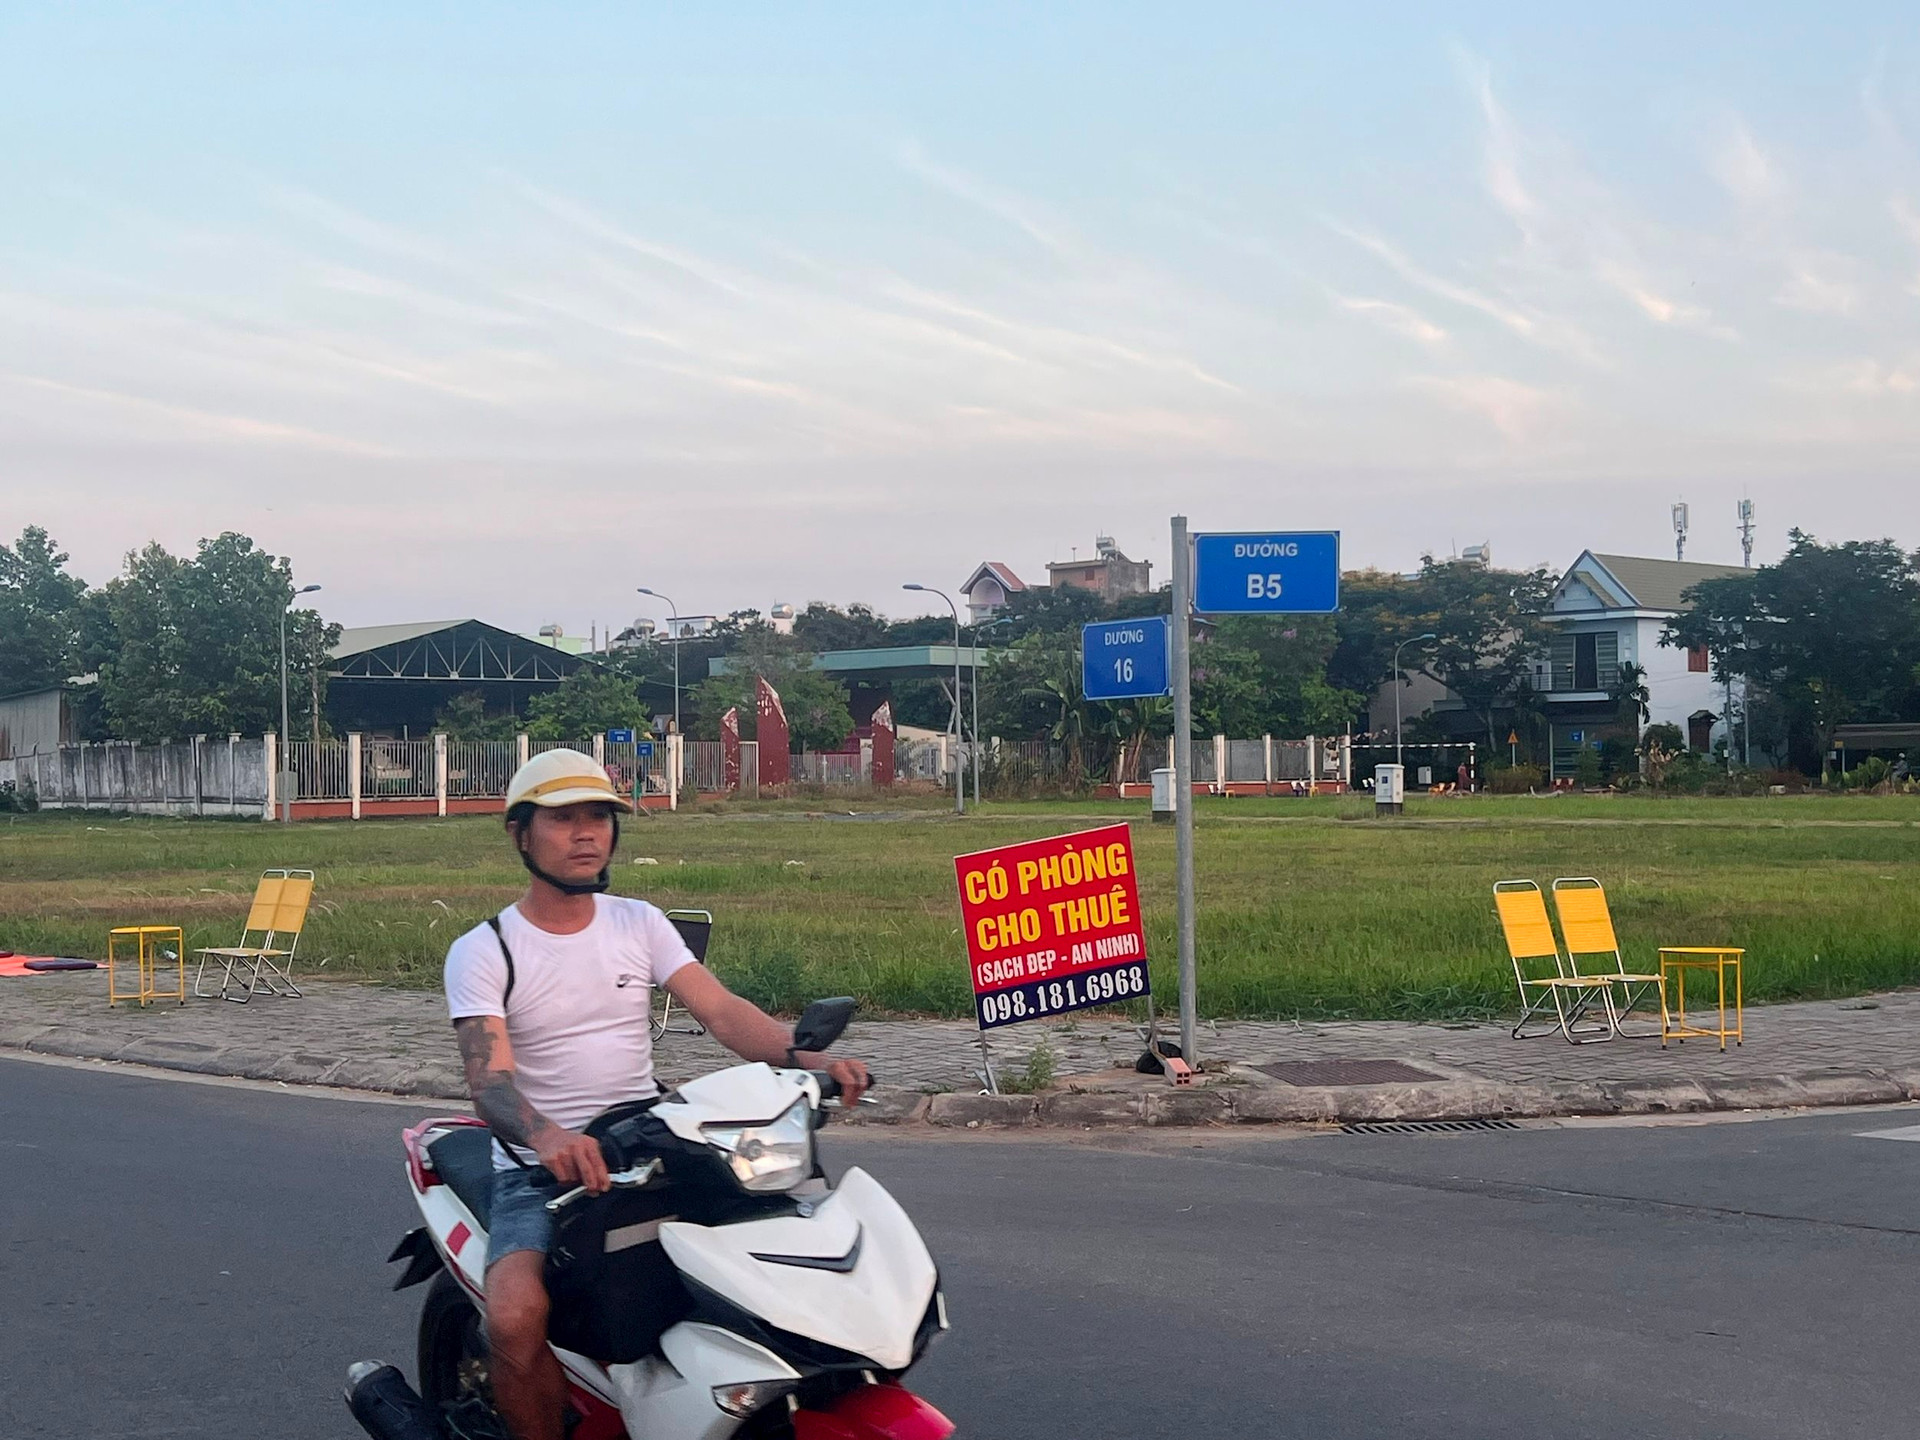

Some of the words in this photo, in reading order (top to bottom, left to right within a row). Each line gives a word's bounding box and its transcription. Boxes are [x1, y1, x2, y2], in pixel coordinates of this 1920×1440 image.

[1234, 539, 1298, 558] ĐƯỜNG
[1247, 574, 1282, 599] B5
[1104, 626, 1144, 646] ĐƯỜNG
[1114, 658, 1133, 683] 16
[964, 859, 1009, 905] CÓ
[1016, 843, 1129, 895] PHÒNG
[976, 908, 1041, 951] CHO
[1048, 883, 1130, 936] THUÊ
[977, 959, 1024, 986] (SẠCH
[1026, 950, 1056, 976] ĐẸP
[1072, 944, 1094, 965] AN
[1096, 934, 1139, 960] NINH)
[982, 966, 1144, 1024] 098.181.6968
